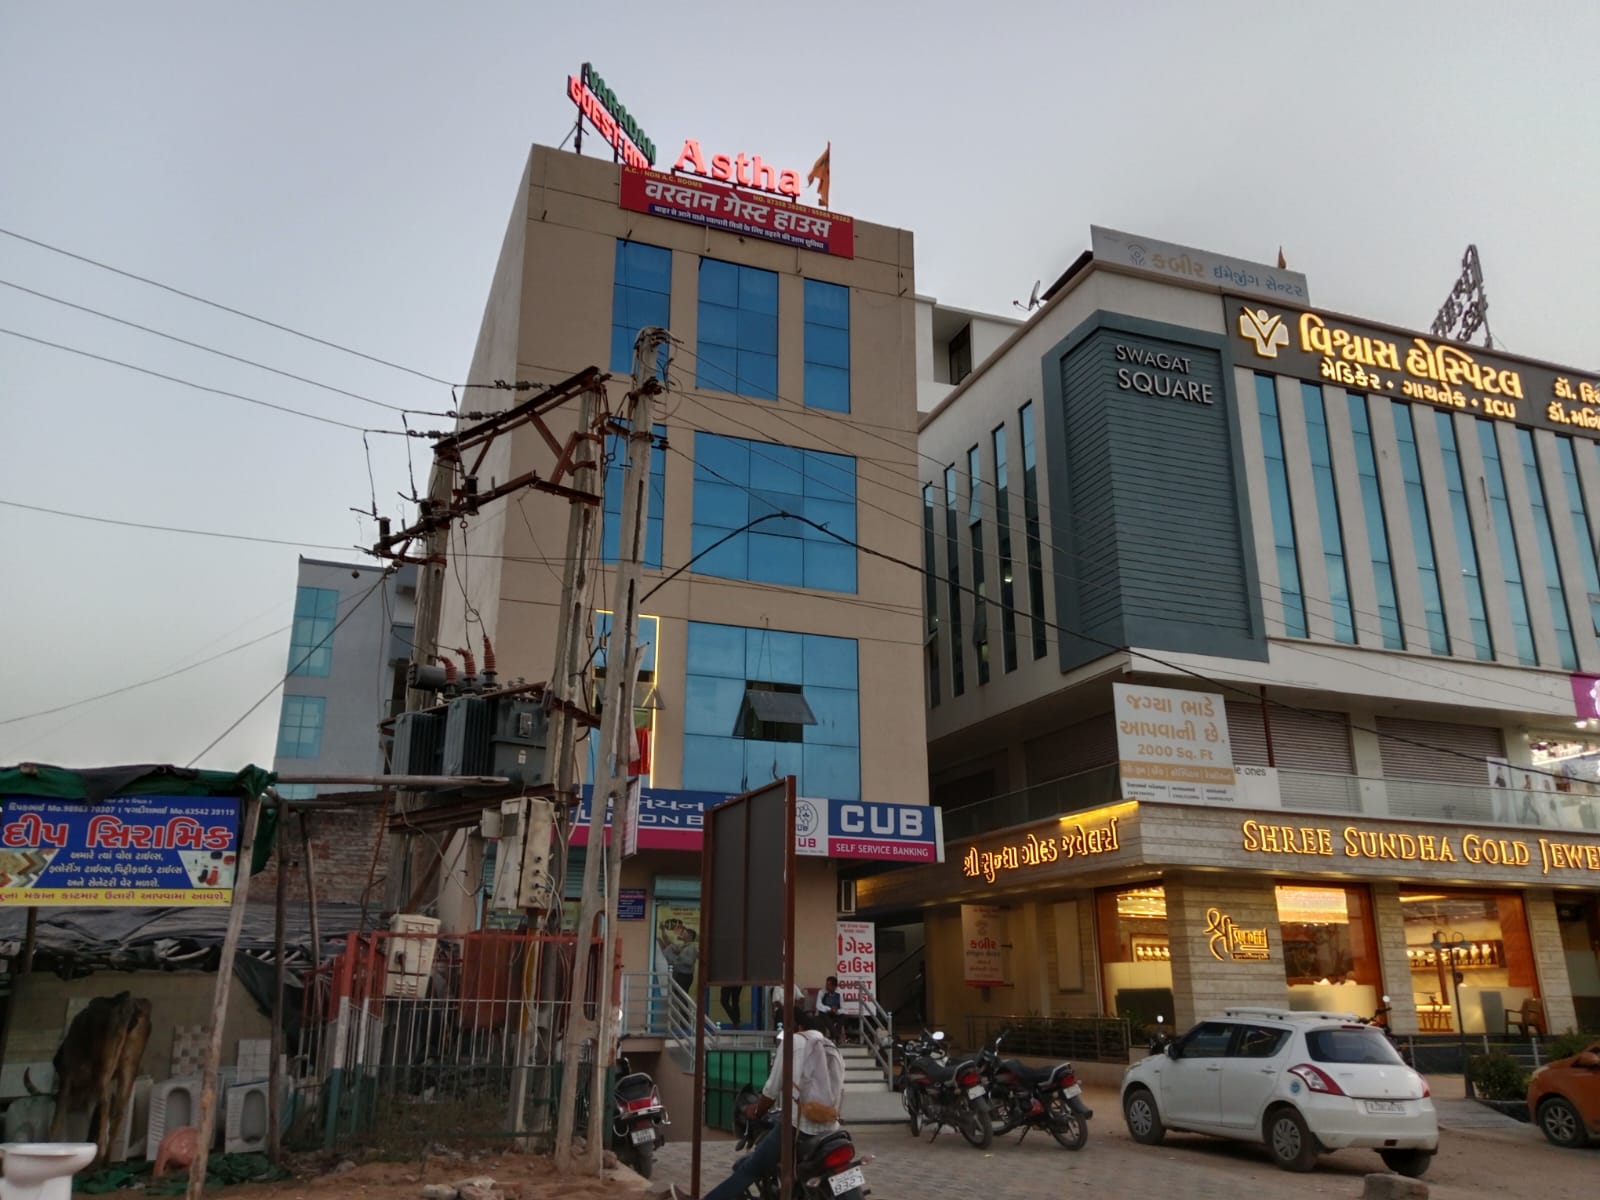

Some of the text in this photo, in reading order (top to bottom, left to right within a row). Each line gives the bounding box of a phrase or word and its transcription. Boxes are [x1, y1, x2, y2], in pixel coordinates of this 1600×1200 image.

[570, 75, 622, 149] GUEST
[674, 138, 800, 197] Astha
[645, 179, 720, 212] वरदान
[723, 191, 770, 223] गेस्ट
[774, 208, 832, 238] हाउस
[1115, 344, 1191, 374] SWAGAT
[1299, 312, 1524, 400] વિશ્વાસ હોસ્પિટલ
[1117, 368, 1214, 405] SQUARE
[1321, 357, 1516, 419] મેડિકેર ગાયનેક ICU
[1125, 693, 1215, 718] જગ્યા ભાડે
[1120, 720, 1196, 741] આપવાની
[1137, 743, 1173, 758] 2000
[2, 812, 234, 850] દીપ સિરામિક
[840, 804, 924, 837] CUB
[836, 843, 857, 853] SELF
[857, 844, 891, 855] SERVICE
[893, 846, 929, 857] BANKING
[1021, 832, 1058, 866] ગોલ્ડ
[1242, 819, 1334, 857] SHREE
[1344, 826, 1457, 863] SUNDHA
[1462, 833, 1531, 867] GOLD
[845, 936, 873, 955] ગેસ્ટ
[837, 956, 874, 974] હાઉસ
